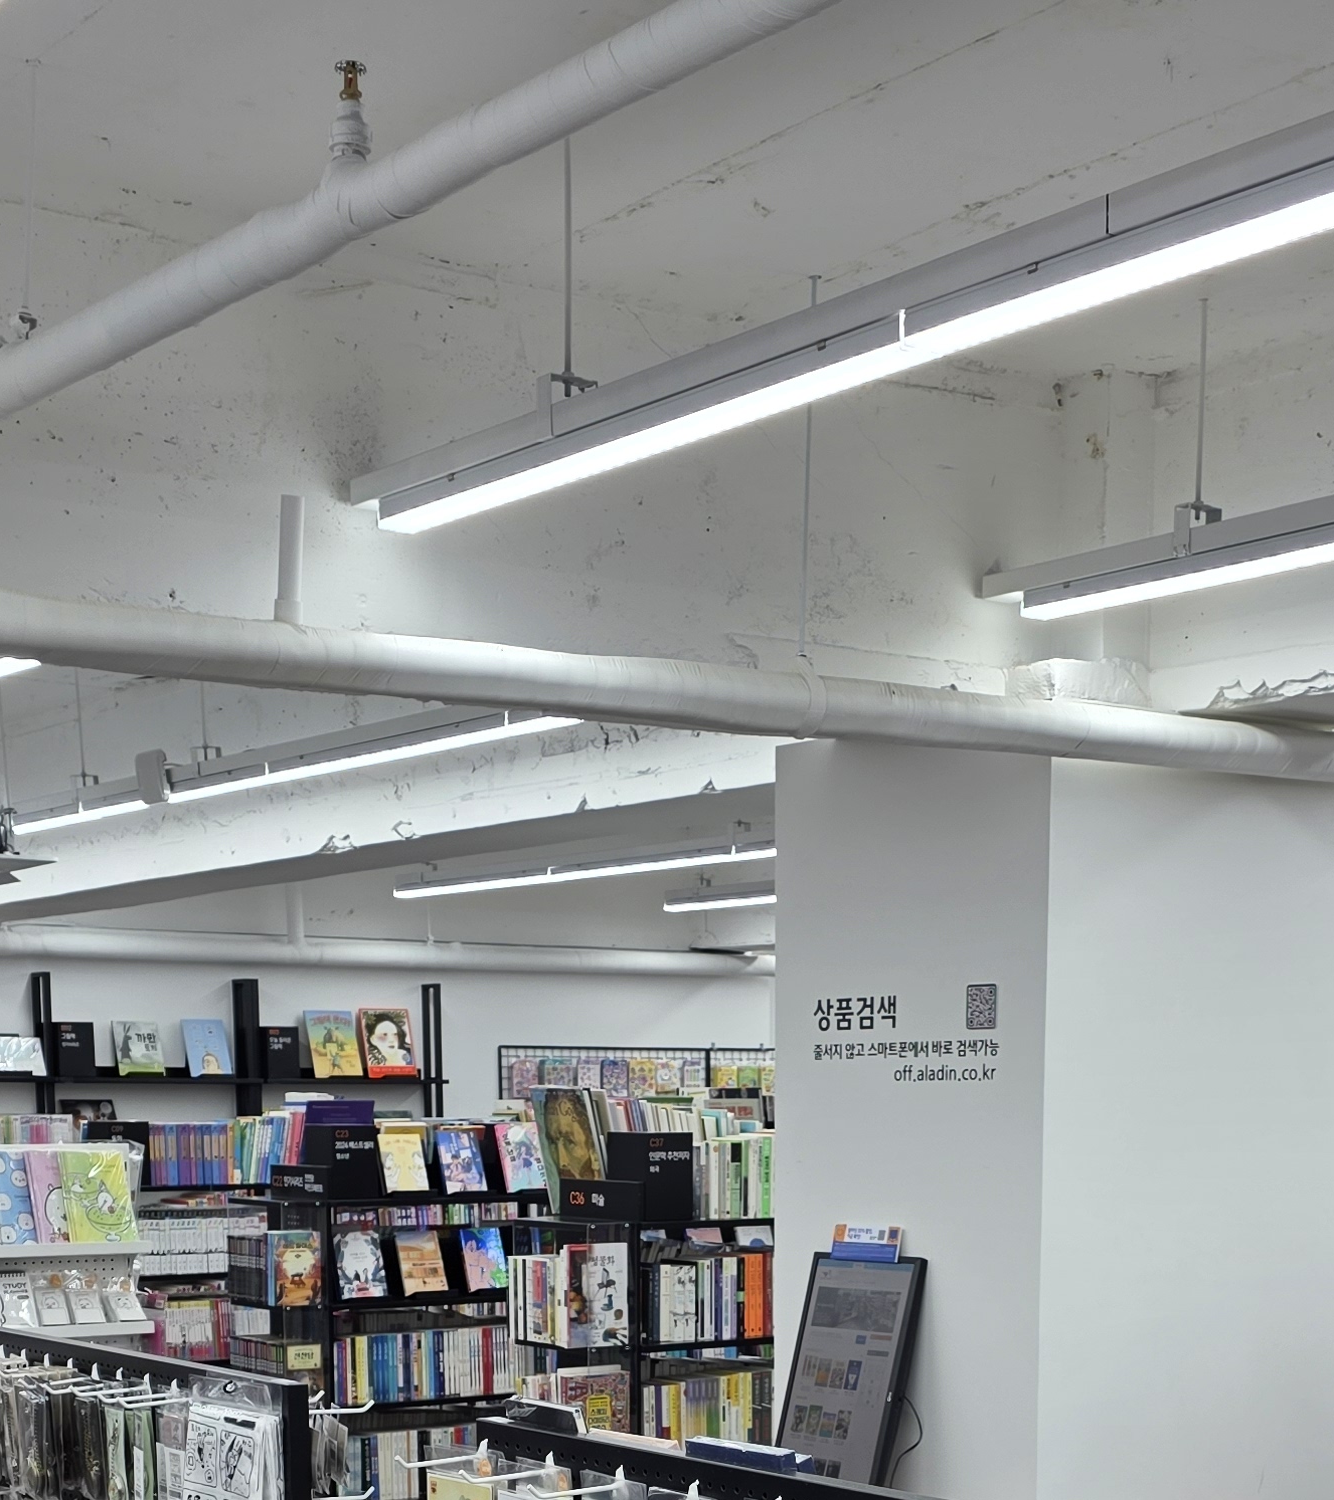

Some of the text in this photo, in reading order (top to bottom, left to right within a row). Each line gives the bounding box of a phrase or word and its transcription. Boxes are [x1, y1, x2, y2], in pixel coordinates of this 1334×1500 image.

[813, 995, 897, 1031] 상품검색
[813, 1039, 999, 1061] 줄서지 않고 스마트폰에서 바로 검색가능
[894, 1064, 997, 1083] off.aladin.co.kr
[336, 1129, 350, 1138] C23
[649, 1138, 663, 1148] C37
[570, 1192, 585, 1205] C36
[591, 1193, 606, 1206] 미술
